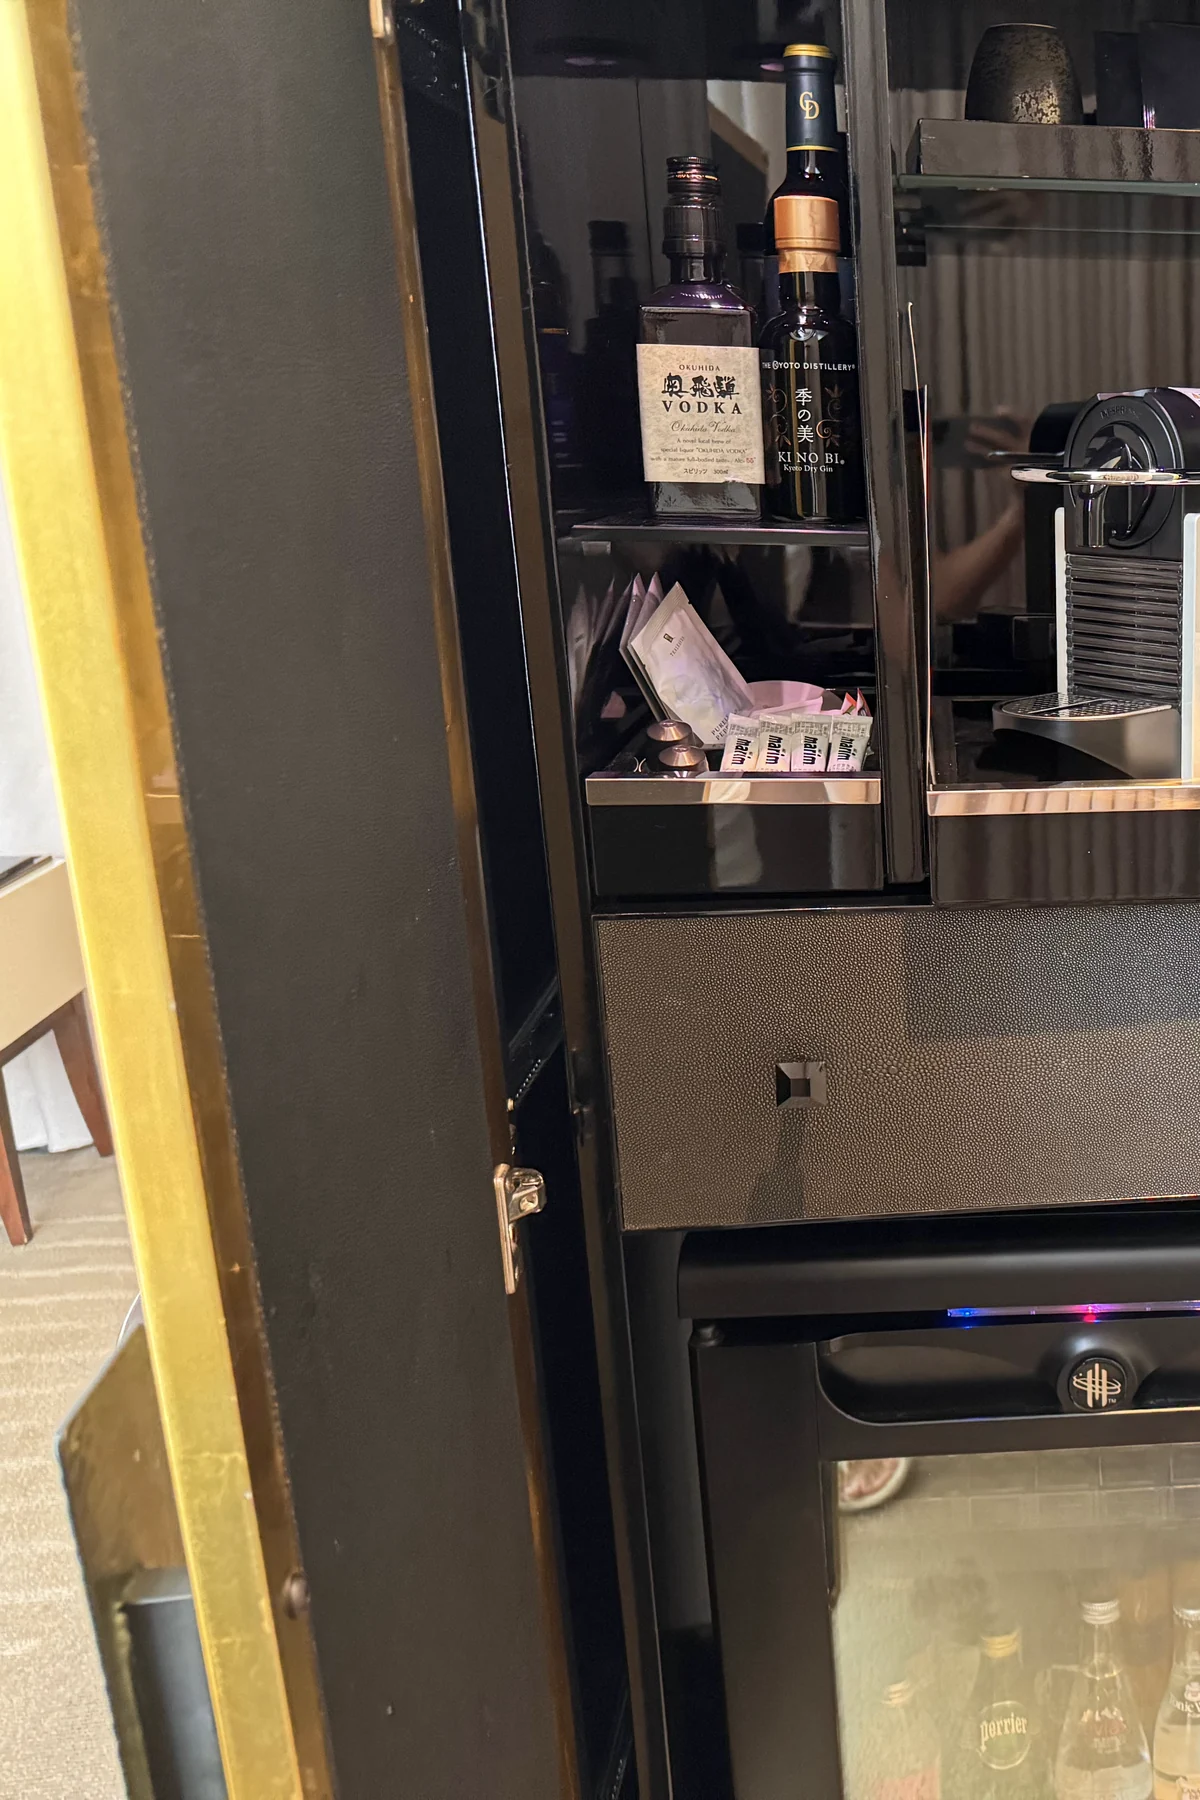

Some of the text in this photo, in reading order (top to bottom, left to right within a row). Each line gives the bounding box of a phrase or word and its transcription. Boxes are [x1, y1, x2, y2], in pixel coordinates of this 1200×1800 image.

[679, 364, 721, 372] OKUHIDA
[772, 360, 801, 370] KYOTO
[662, 400, 742, 414] VODKA
[795, 387, 814, 443] 季の美
[709, 420, 736, 433] Vodka
[778, 451, 791, 463] KI
[796, 452, 819, 464] NO
[783, 464, 833, 473] Kyoto Dry Gin
